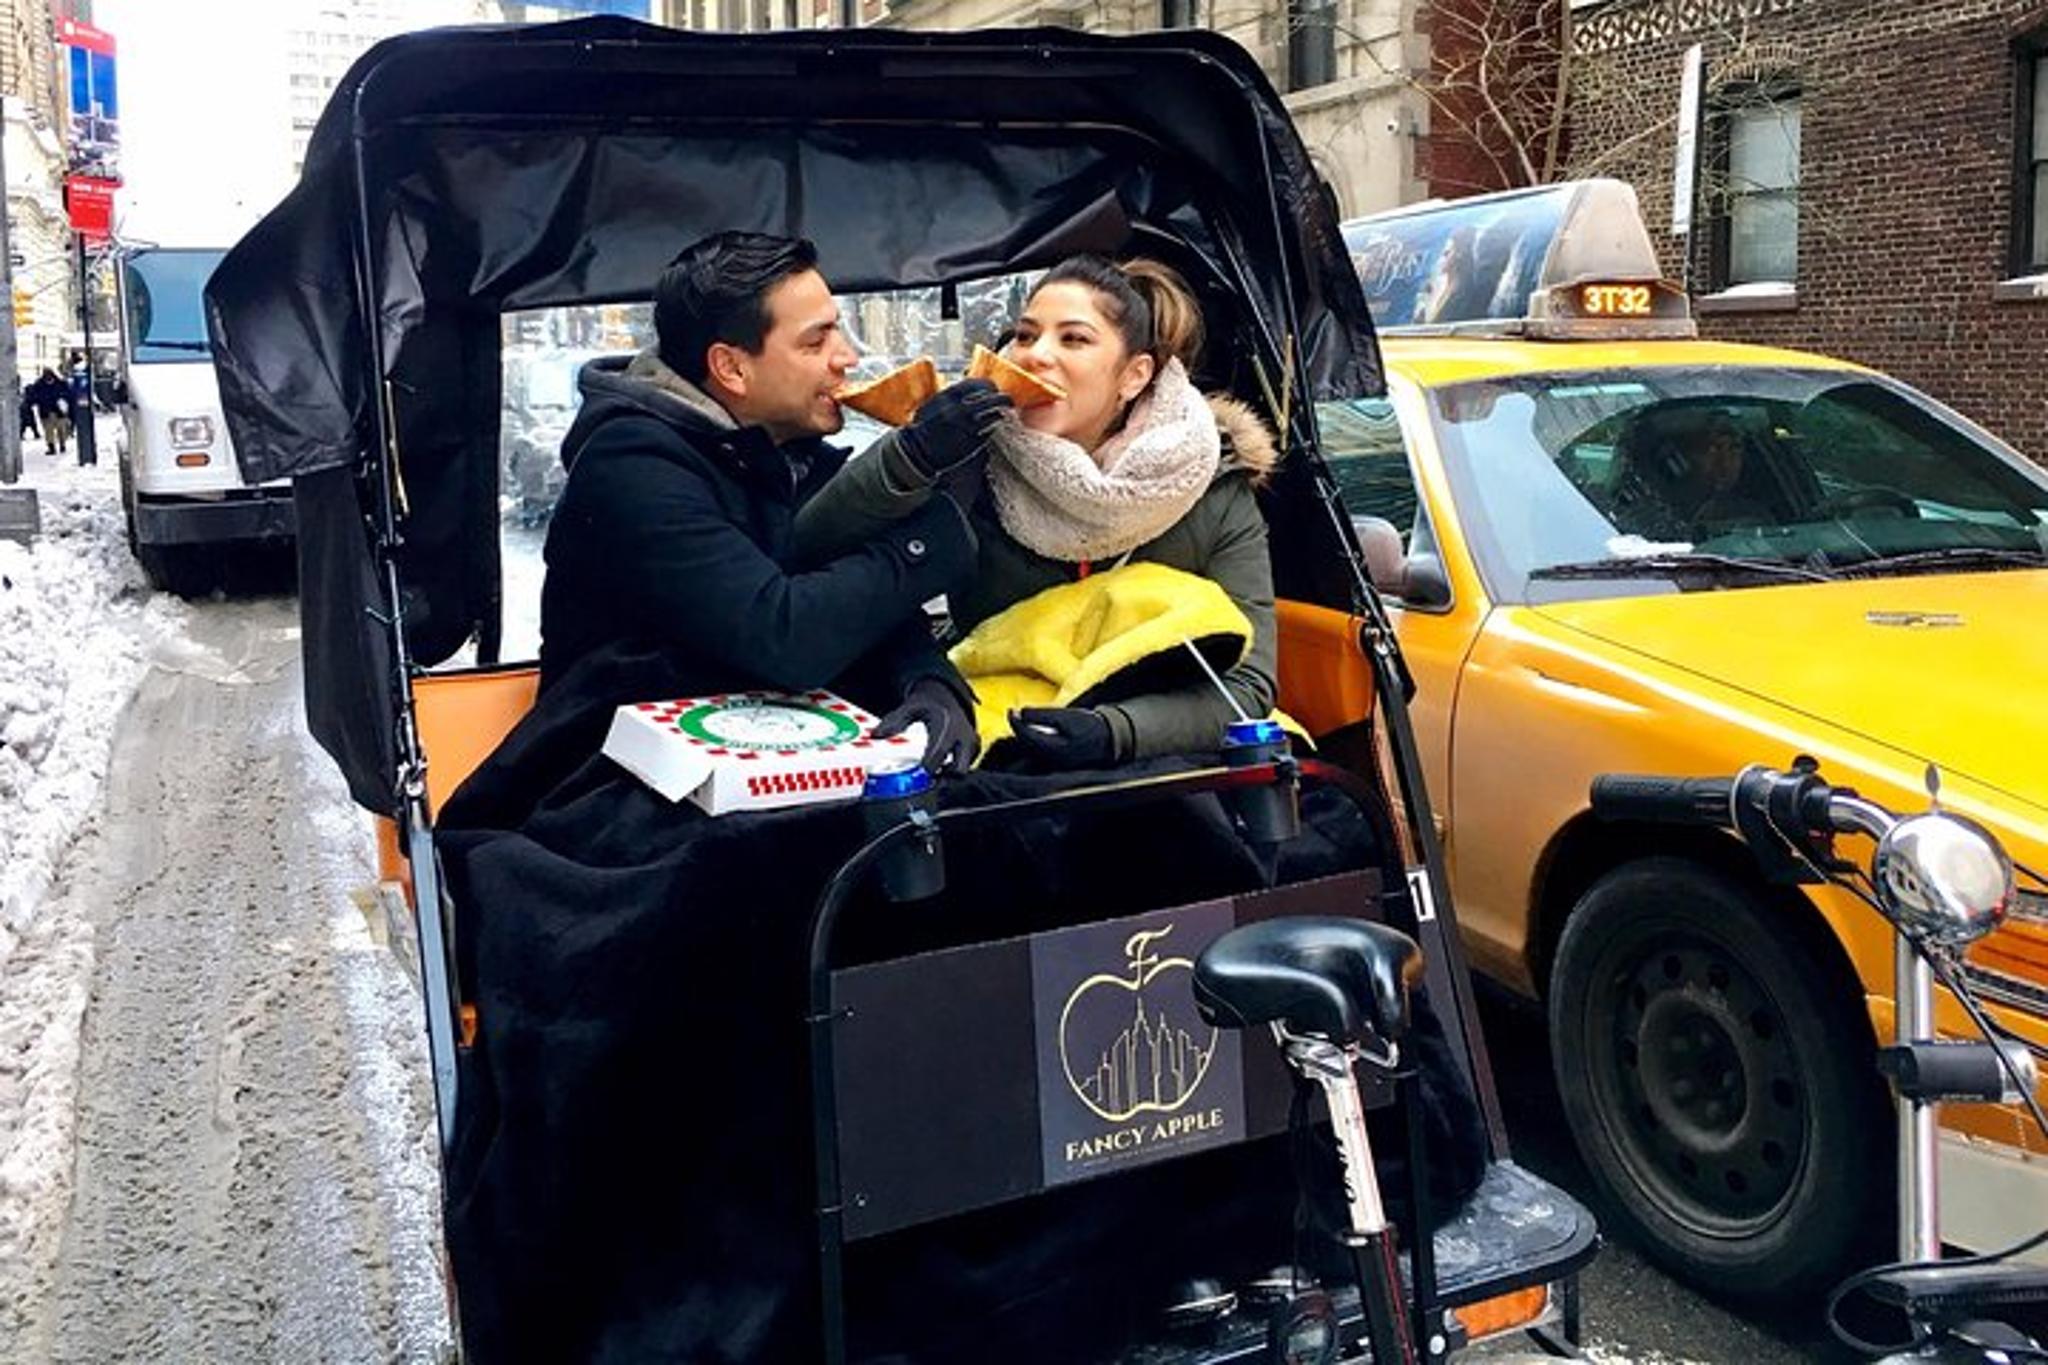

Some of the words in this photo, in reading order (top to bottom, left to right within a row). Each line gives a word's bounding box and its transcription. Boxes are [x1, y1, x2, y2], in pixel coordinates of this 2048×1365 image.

[1584, 286, 1651, 314] 3T32
[1065, 1126, 1147, 1161] FANCY
[1151, 1108, 1224, 1141] APPLE
